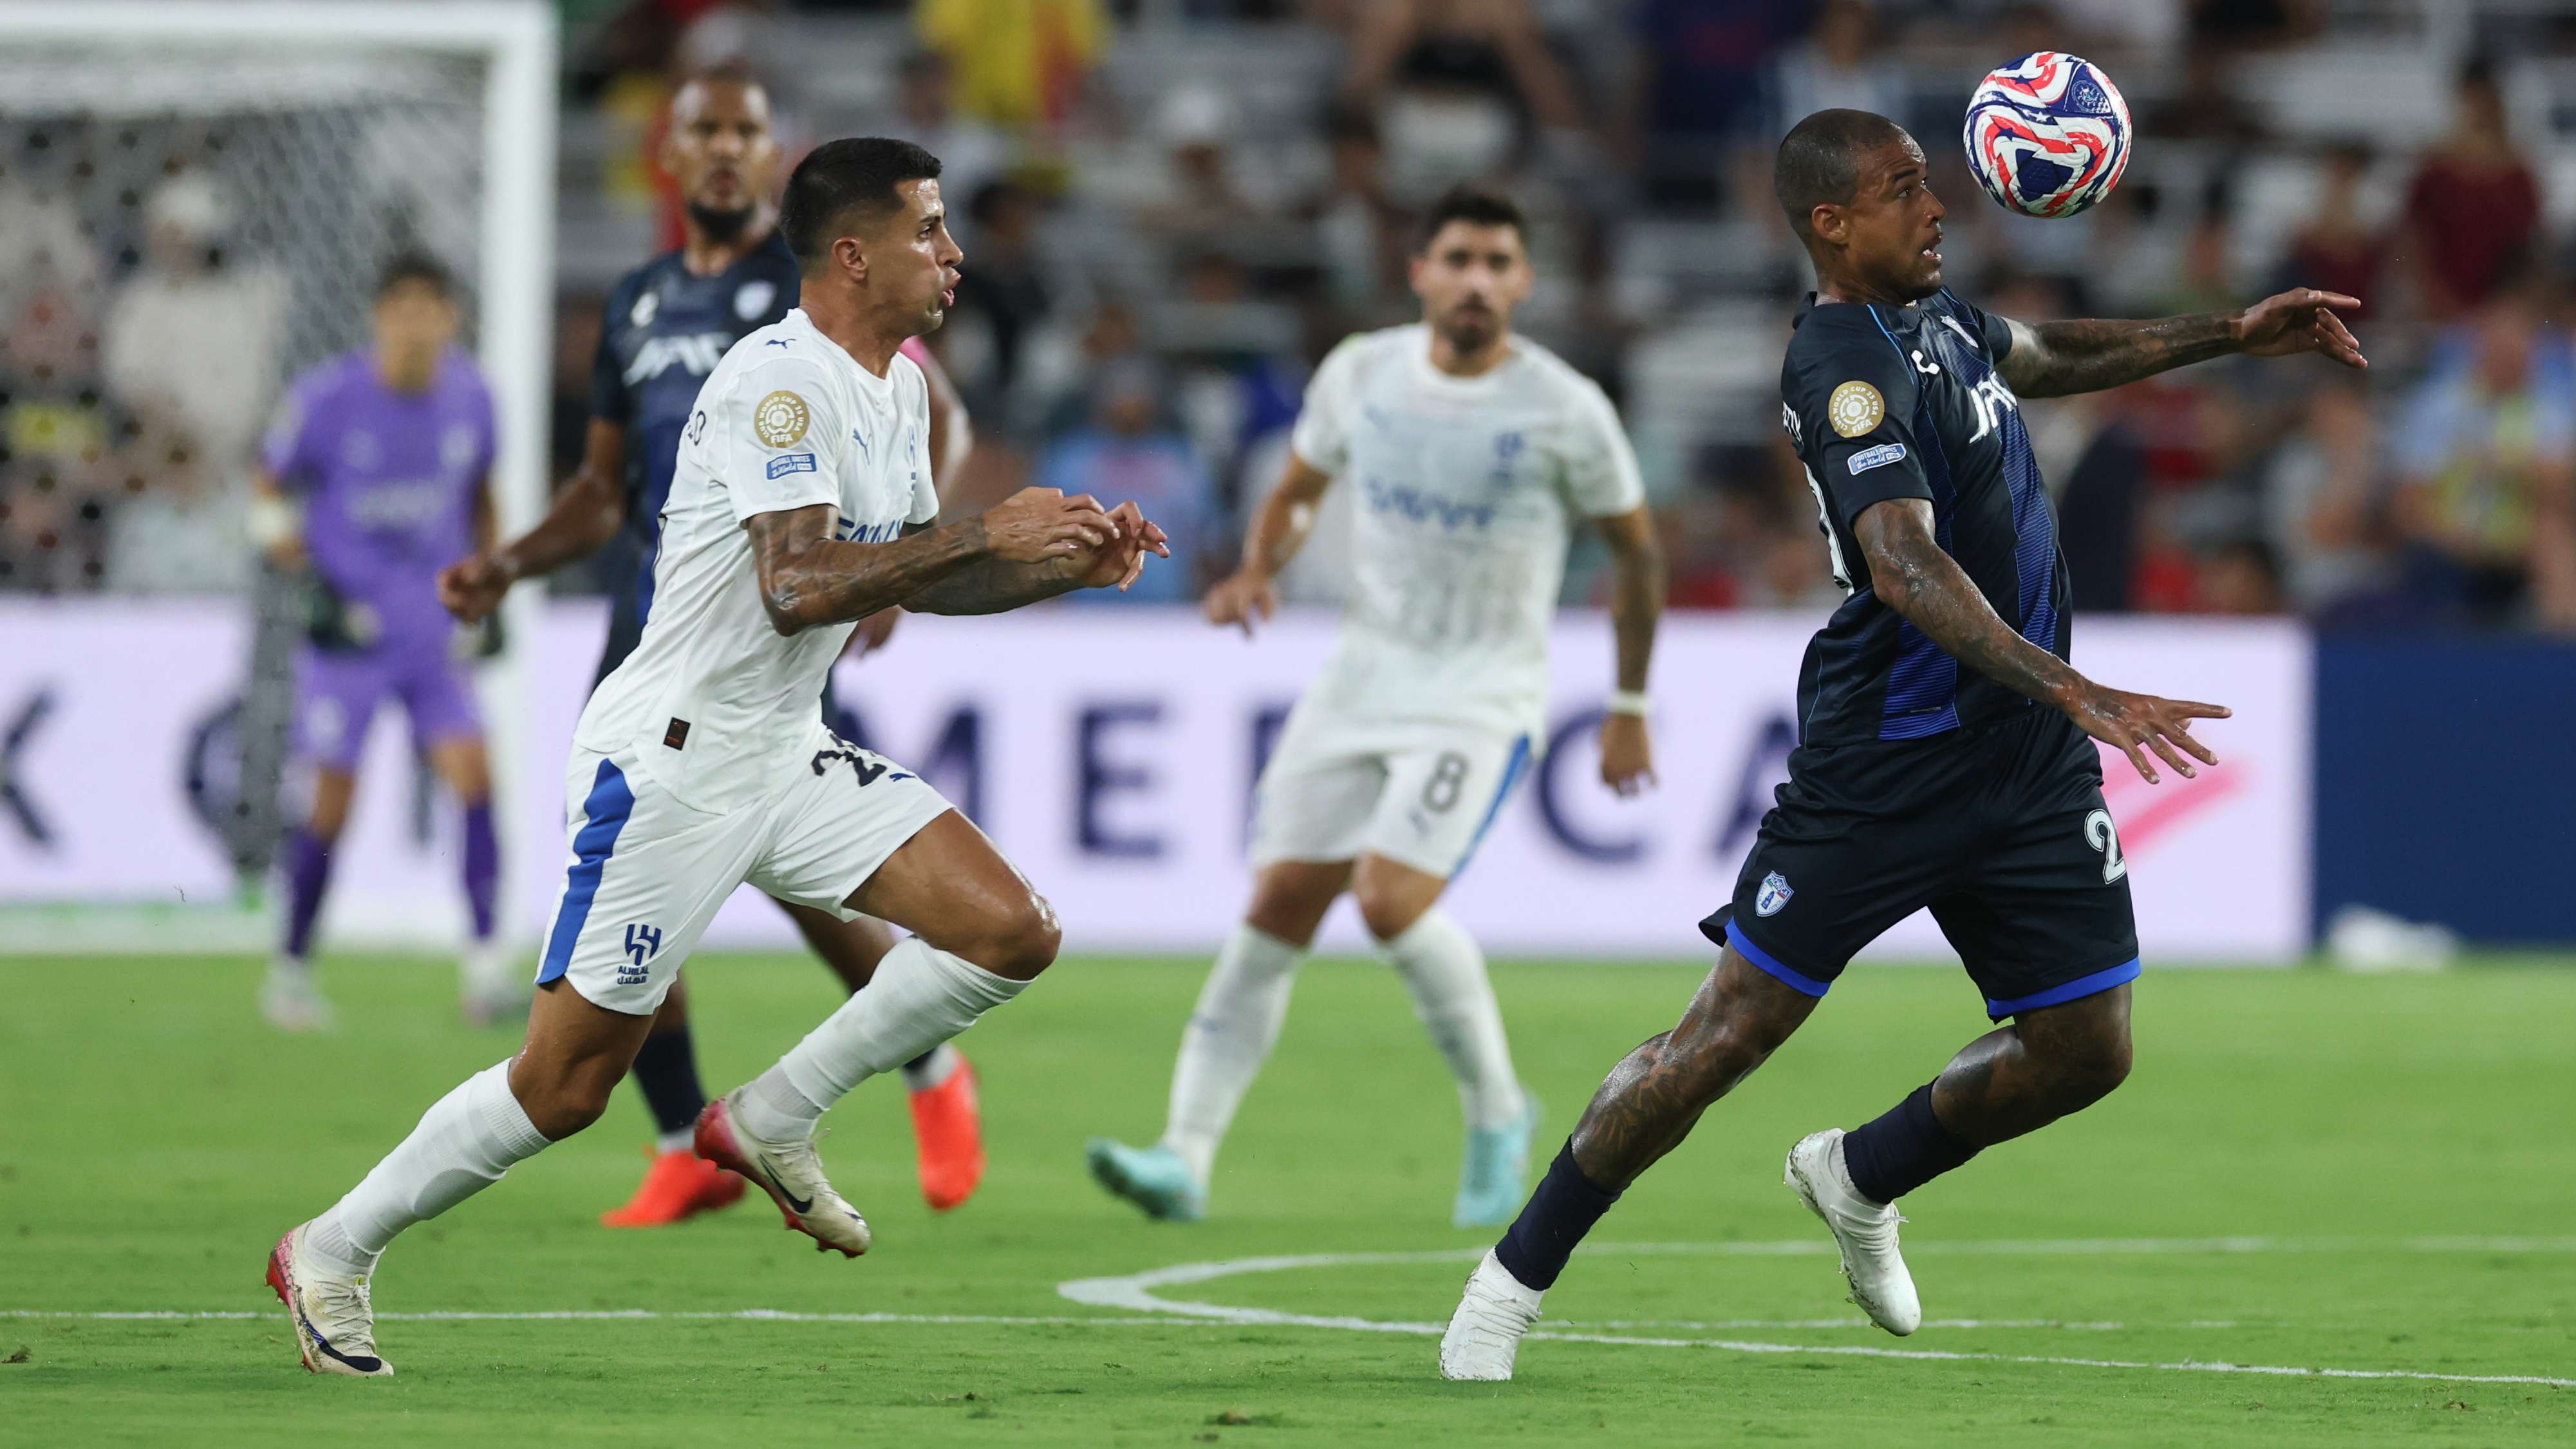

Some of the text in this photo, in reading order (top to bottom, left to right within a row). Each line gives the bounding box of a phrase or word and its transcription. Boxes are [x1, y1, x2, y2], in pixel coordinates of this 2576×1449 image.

[759, 397, 779, 418] WORLD
[794, 417, 804, 431] USA
[1833, 389, 1848, 414] WORLD
[1834, 416, 1848, 431] CLUB
[1852, 419, 1874, 433] FIFA
[770, 434, 793, 443] FIFA
[812, 733, 887, 787] 2
[1422, 750, 1469, 814] 8
